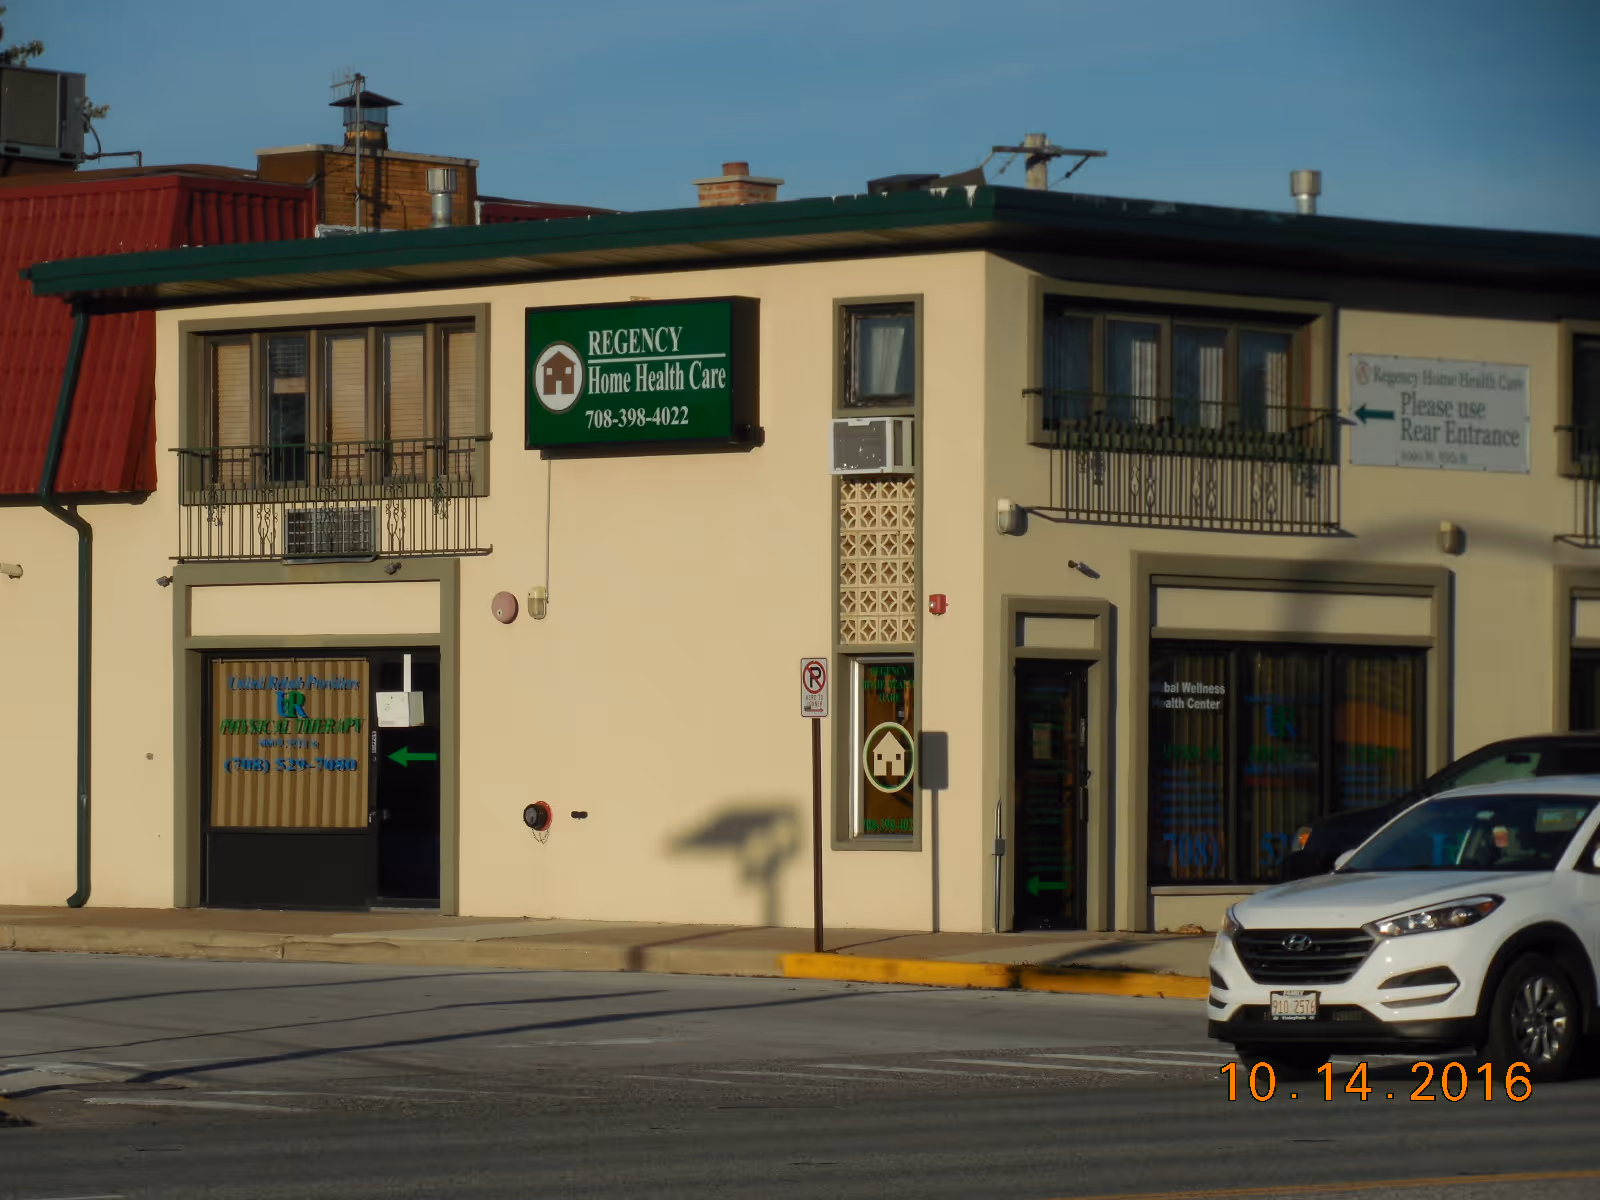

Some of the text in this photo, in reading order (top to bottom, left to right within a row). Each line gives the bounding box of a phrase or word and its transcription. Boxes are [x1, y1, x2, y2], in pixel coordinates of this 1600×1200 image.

[588, 326, 683, 356] REGENCY
[588, 360, 726, 394] Home Health Care
[1373, 365, 1524, 391] Regency Home Health Care
[585, 405, 689, 430] 708-398-4022
[1401, 391, 1486, 420] Please use
[1401, 418, 1520, 447] Rear Entrance
[1181, 681, 1225, 694] Wellness
[1186, 697, 1220, 709] Center
[220, 717, 365, 735] PHYSICAL THERAPY
[224, 757, 270, 774] (708)
